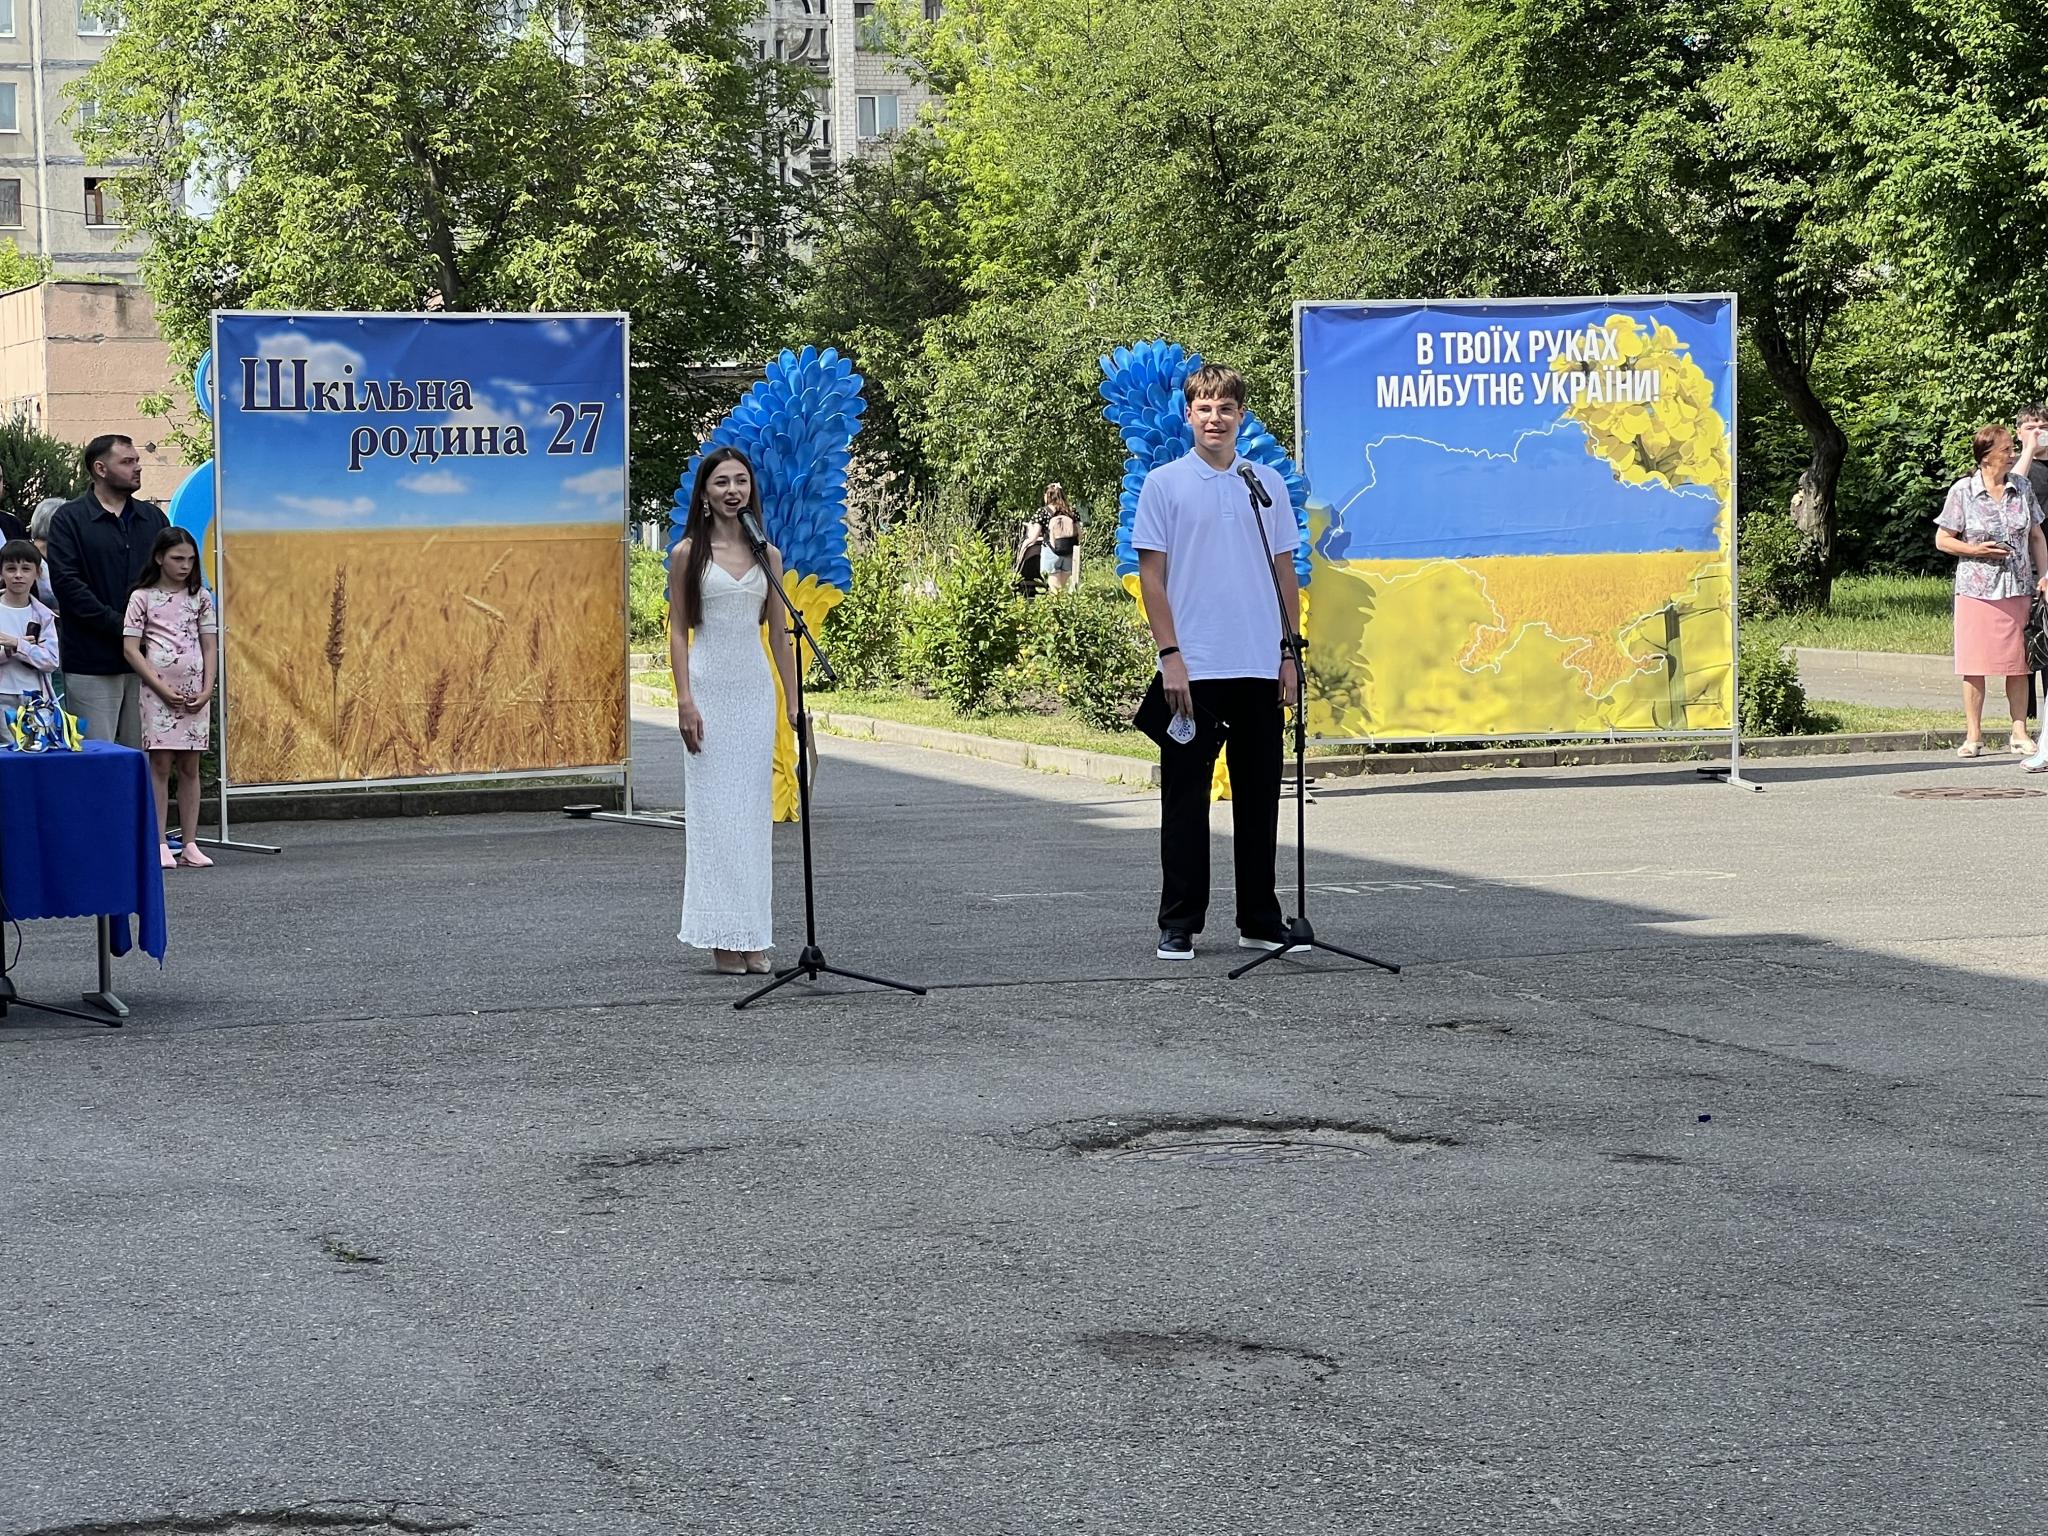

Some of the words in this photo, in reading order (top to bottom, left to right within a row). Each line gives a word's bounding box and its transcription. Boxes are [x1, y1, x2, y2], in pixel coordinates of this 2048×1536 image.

[1416, 332, 1433, 366] В
[1440, 325, 1521, 364] ТВОЇХ
[1529, 328, 1619, 362] РУКАХ
[240, 357, 473, 413] Шкільна
[1376, 370, 1525, 408] МАЙБУТНЄ
[1533, 366, 1660, 405] УКРАЇНИ!
[347, 423, 528, 472] родина
[546, 402, 605, 456] 27
